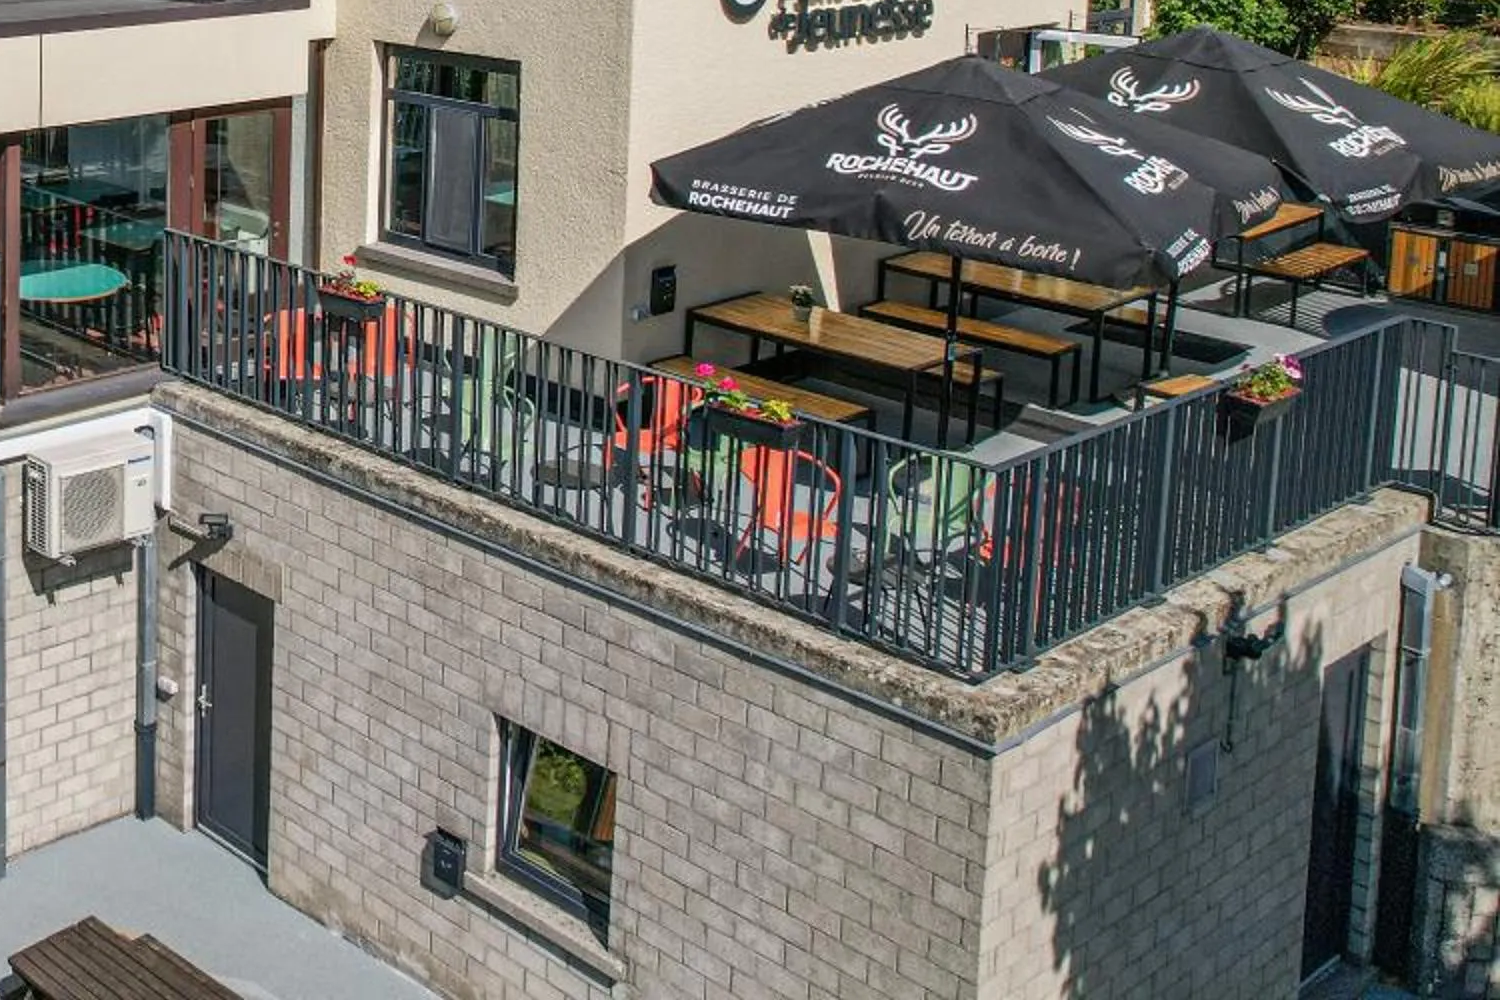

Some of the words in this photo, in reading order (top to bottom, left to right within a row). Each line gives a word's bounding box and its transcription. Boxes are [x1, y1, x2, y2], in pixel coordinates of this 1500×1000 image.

[826, 152, 978, 191] ROCHEHAUT
[688, 191, 795, 219] ROCHEHAUT
[691, 179, 772, 201] BRASSERIE
[777, 193, 799, 205] DE
[903, 209, 941, 241] Un
[943, 219, 998, 248] terroir
